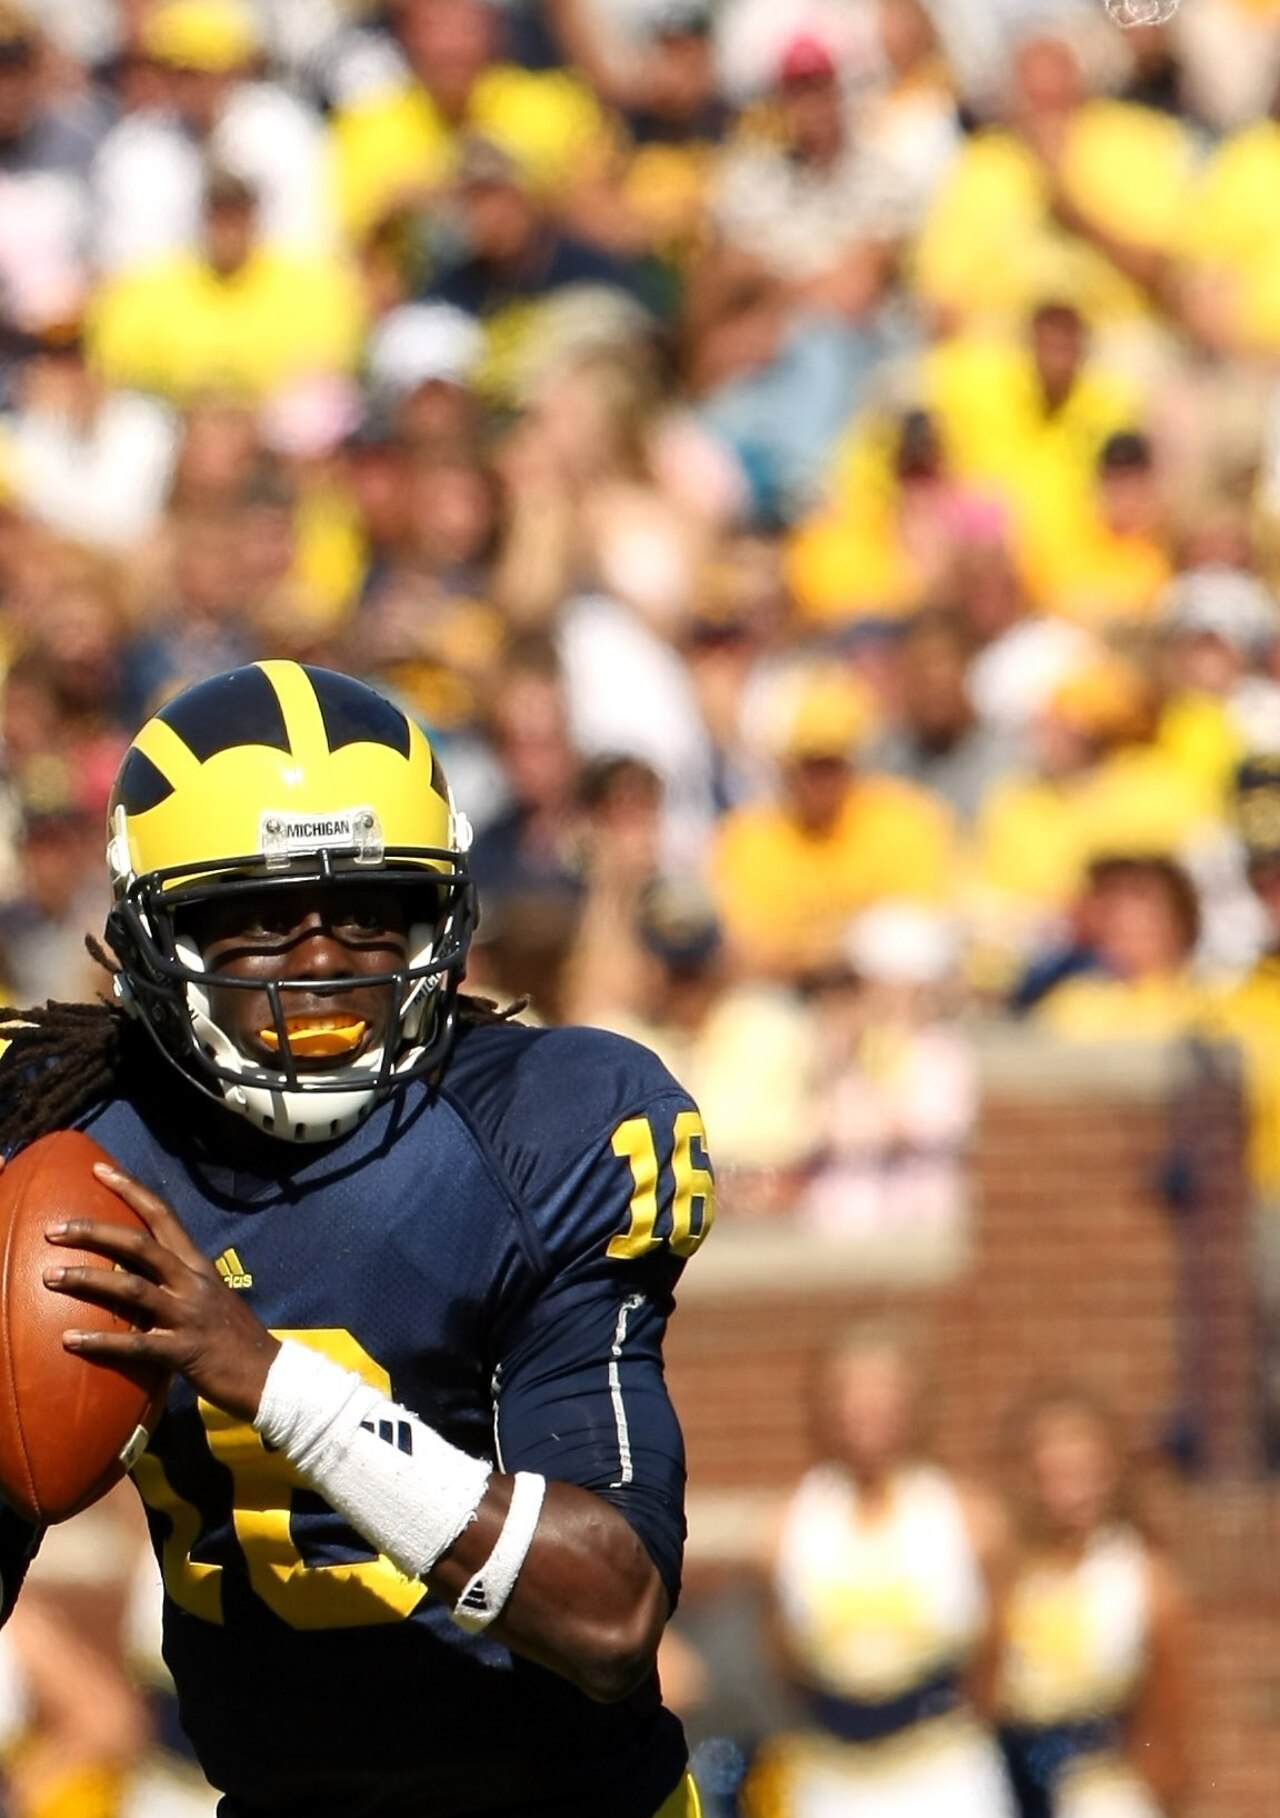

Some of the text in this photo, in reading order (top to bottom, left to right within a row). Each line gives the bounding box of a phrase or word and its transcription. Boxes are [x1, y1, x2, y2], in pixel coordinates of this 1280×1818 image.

[286, 820, 350, 838] MICHIGAN
[605, 1110, 715, 1260] 16
[223, 1273, 253, 1289] das
